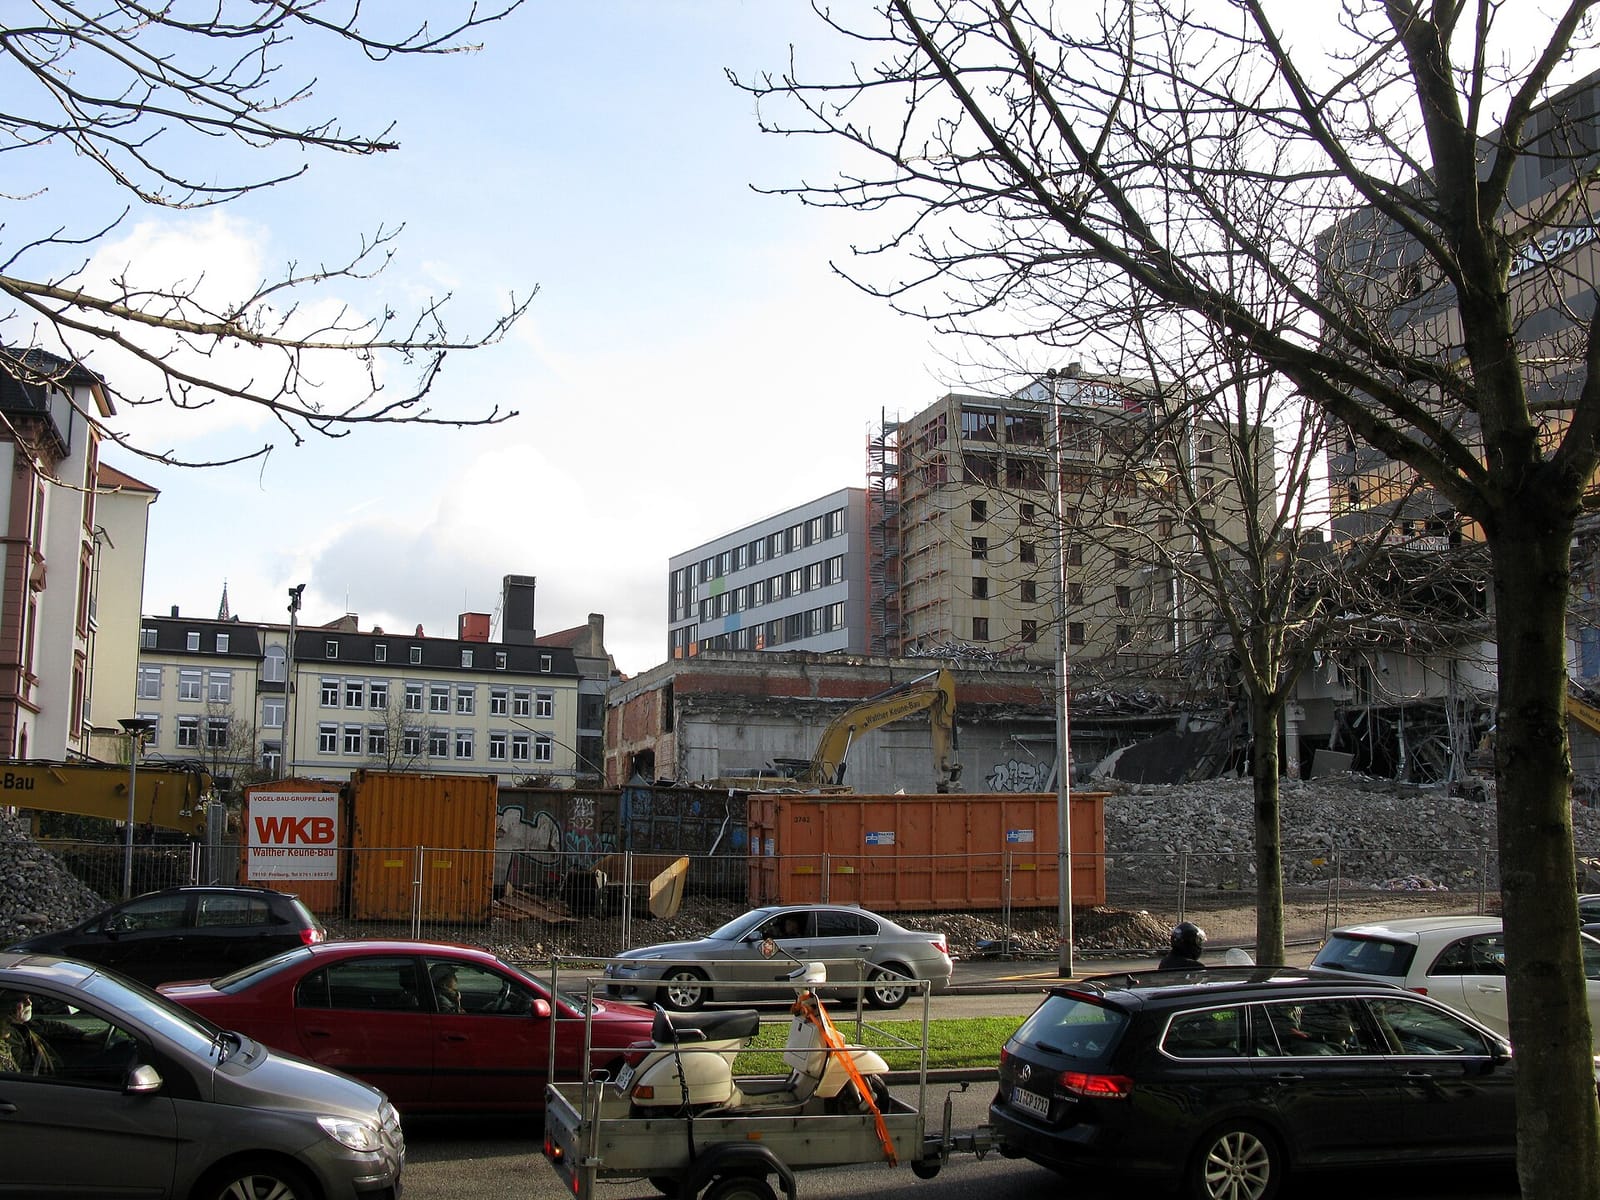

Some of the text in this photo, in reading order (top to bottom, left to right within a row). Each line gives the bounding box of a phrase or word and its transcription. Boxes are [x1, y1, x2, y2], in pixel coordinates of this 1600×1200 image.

[254, 817, 335, 844] WKB
[253, 848, 334, 857] Walther Keune-Bau
